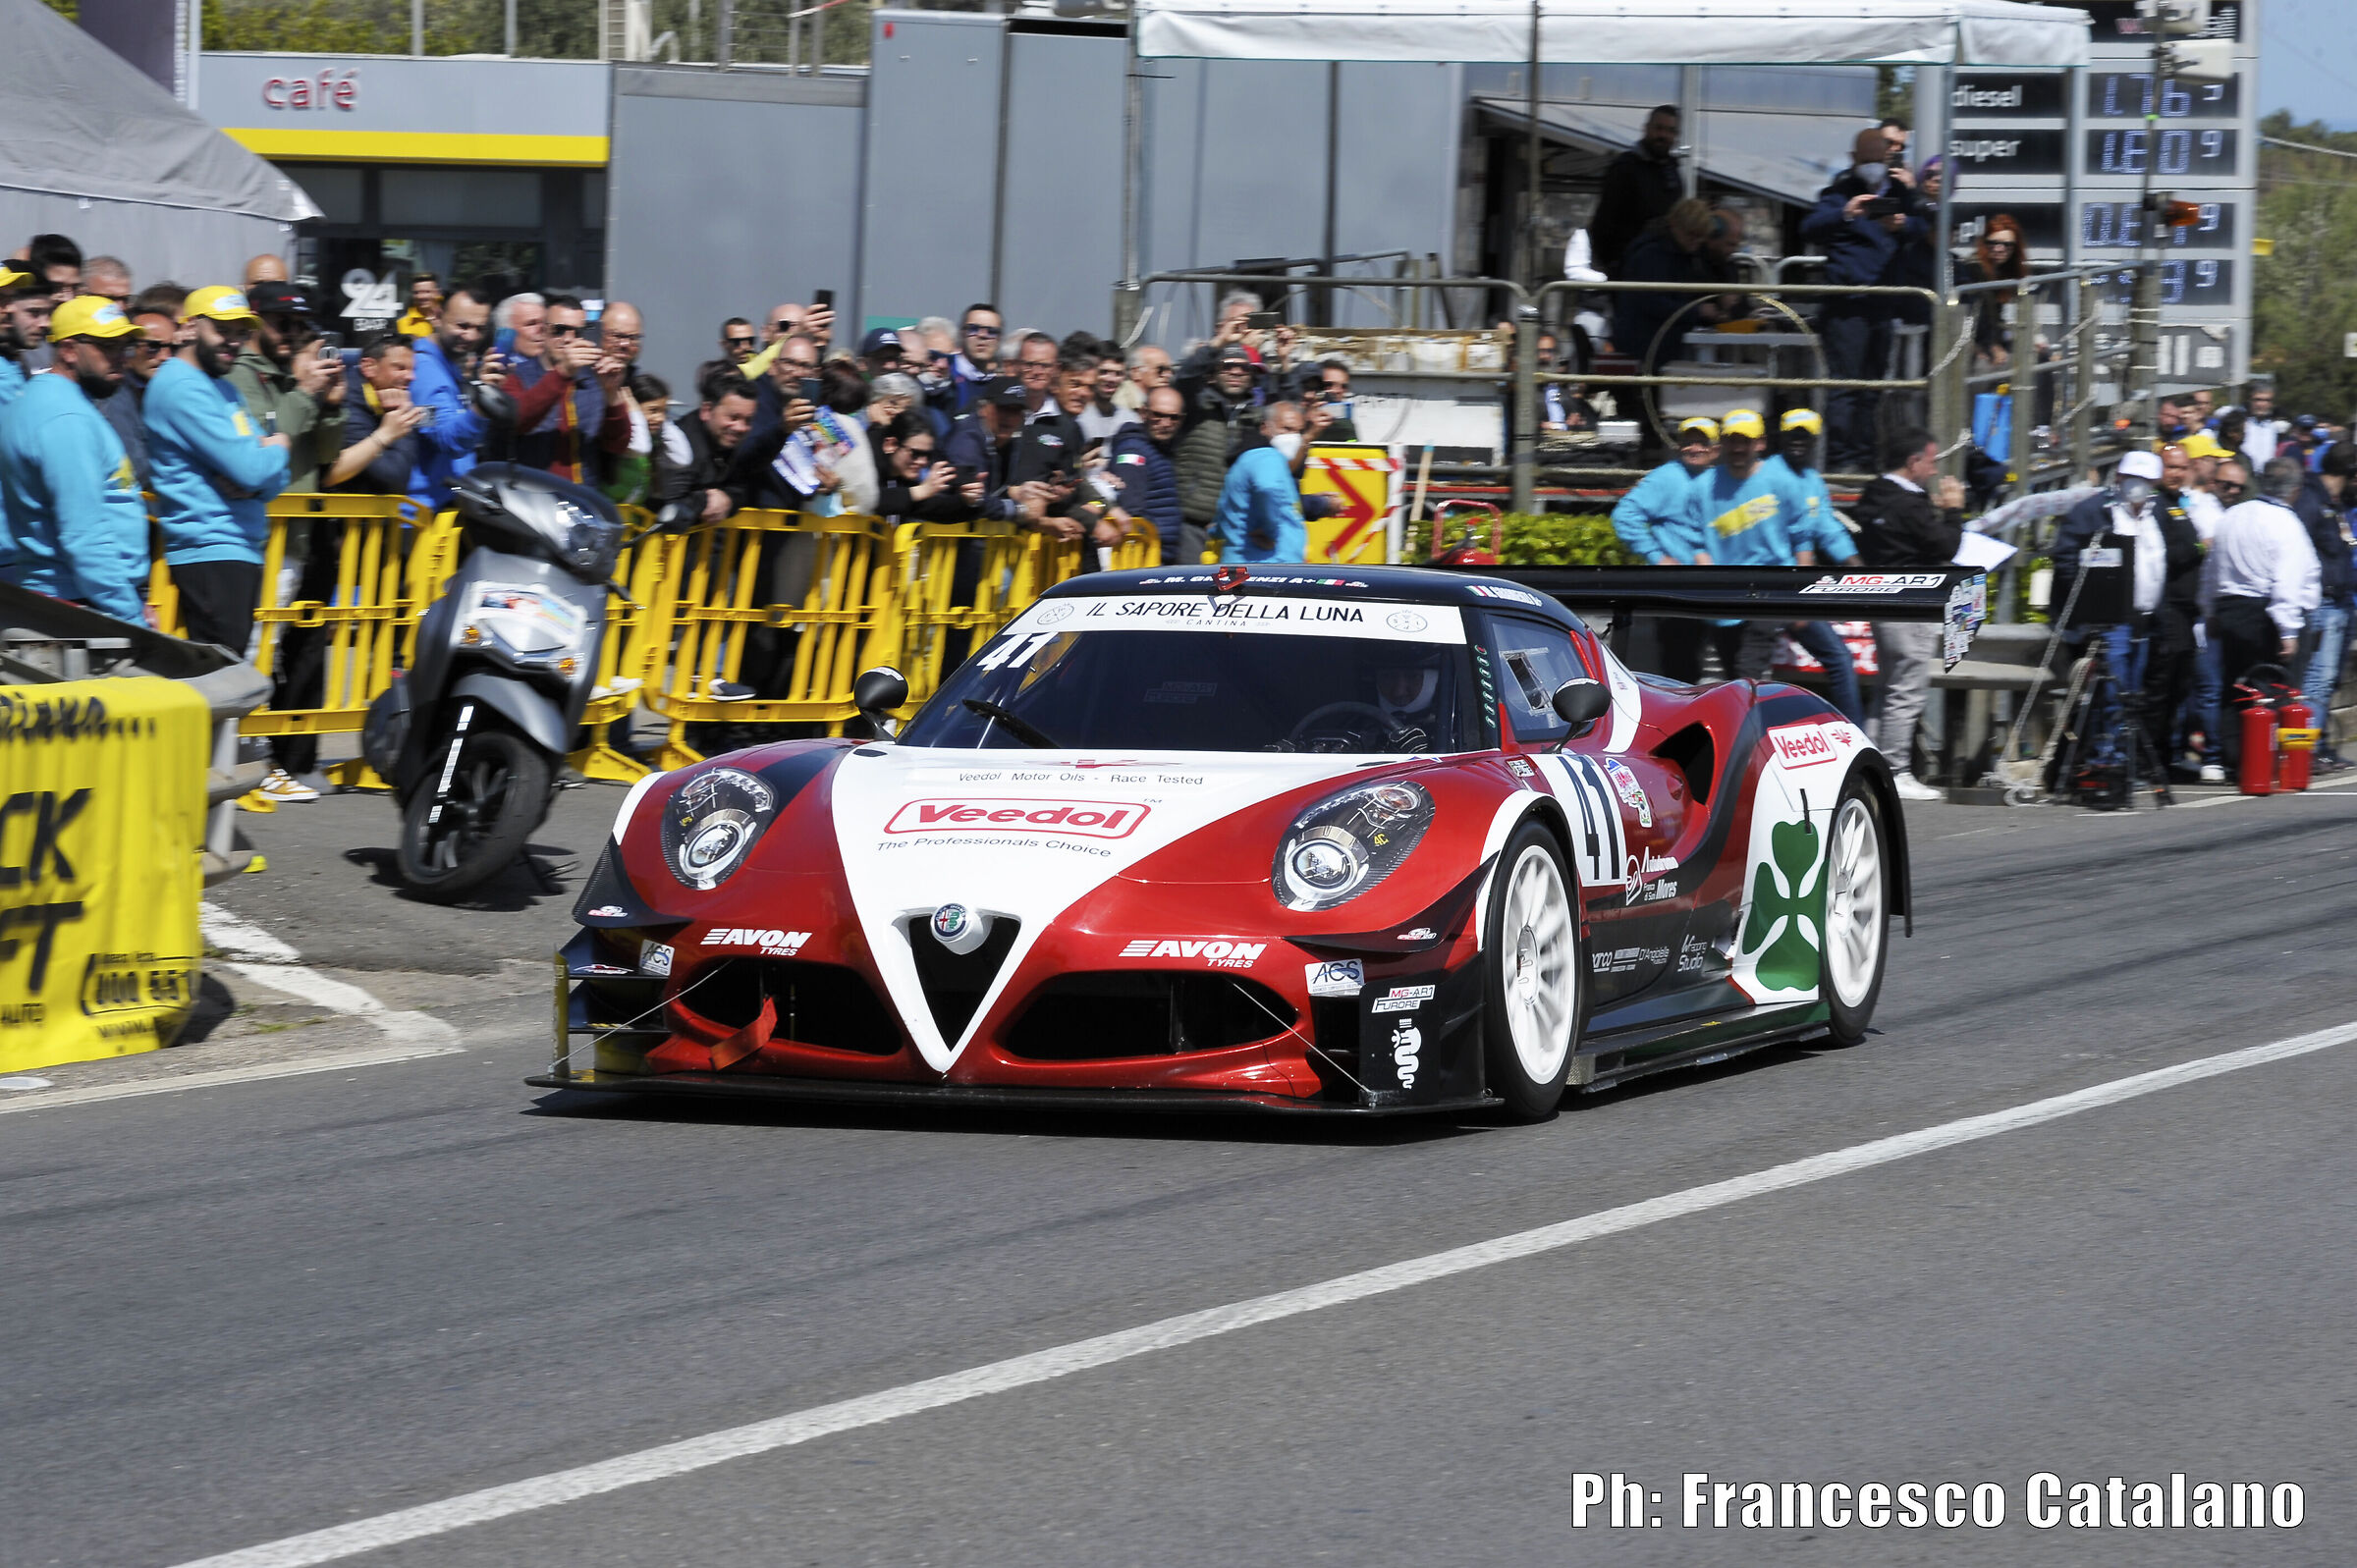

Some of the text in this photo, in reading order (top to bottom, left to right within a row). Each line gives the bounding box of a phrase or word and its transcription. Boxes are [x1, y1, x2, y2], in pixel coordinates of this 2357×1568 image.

[262, 67, 359, 109] café
[339, 267, 404, 318] 24
[1842, 575, 1942, 585] MG-AR1
[1085, 602, 1108, 617] IL
[1115, 601, 1208, 618] SAPORE
[1212, 603, 1289, 620] DELLA
[1299, 606, 1364, 622] LUNA
[1186, 619, 1247, 627] CANTINA
[976, 631, 1059, 672] 41
[1774, 730, 1831, 760] Veedol
[959, 772, 1002, 782] Veedol
[1012, 773, 1053, 782] Motor
[1060, 772, 1085, 782] Oils
[1111, 773, 1147, 784] Race
[1157, 774, 1204, 785] Tested
[919, 804, 1130, 830] Veedol
[877, 837, 1112, 858] The Professionals Choice
[720, 928, 813, 948] AVON
[642, 943, 672, 966] ACS
[759, 946, 798, 956] TYRES
[1149, 940, 1268, 960] AVON
[1207, 958, 1254, 968] TYRES
[1312, 960, 1360, 984] ACS
[1390, 986, 1434, 999] MG-AR1
[1375, 999, 1419, 1011] FURORE
